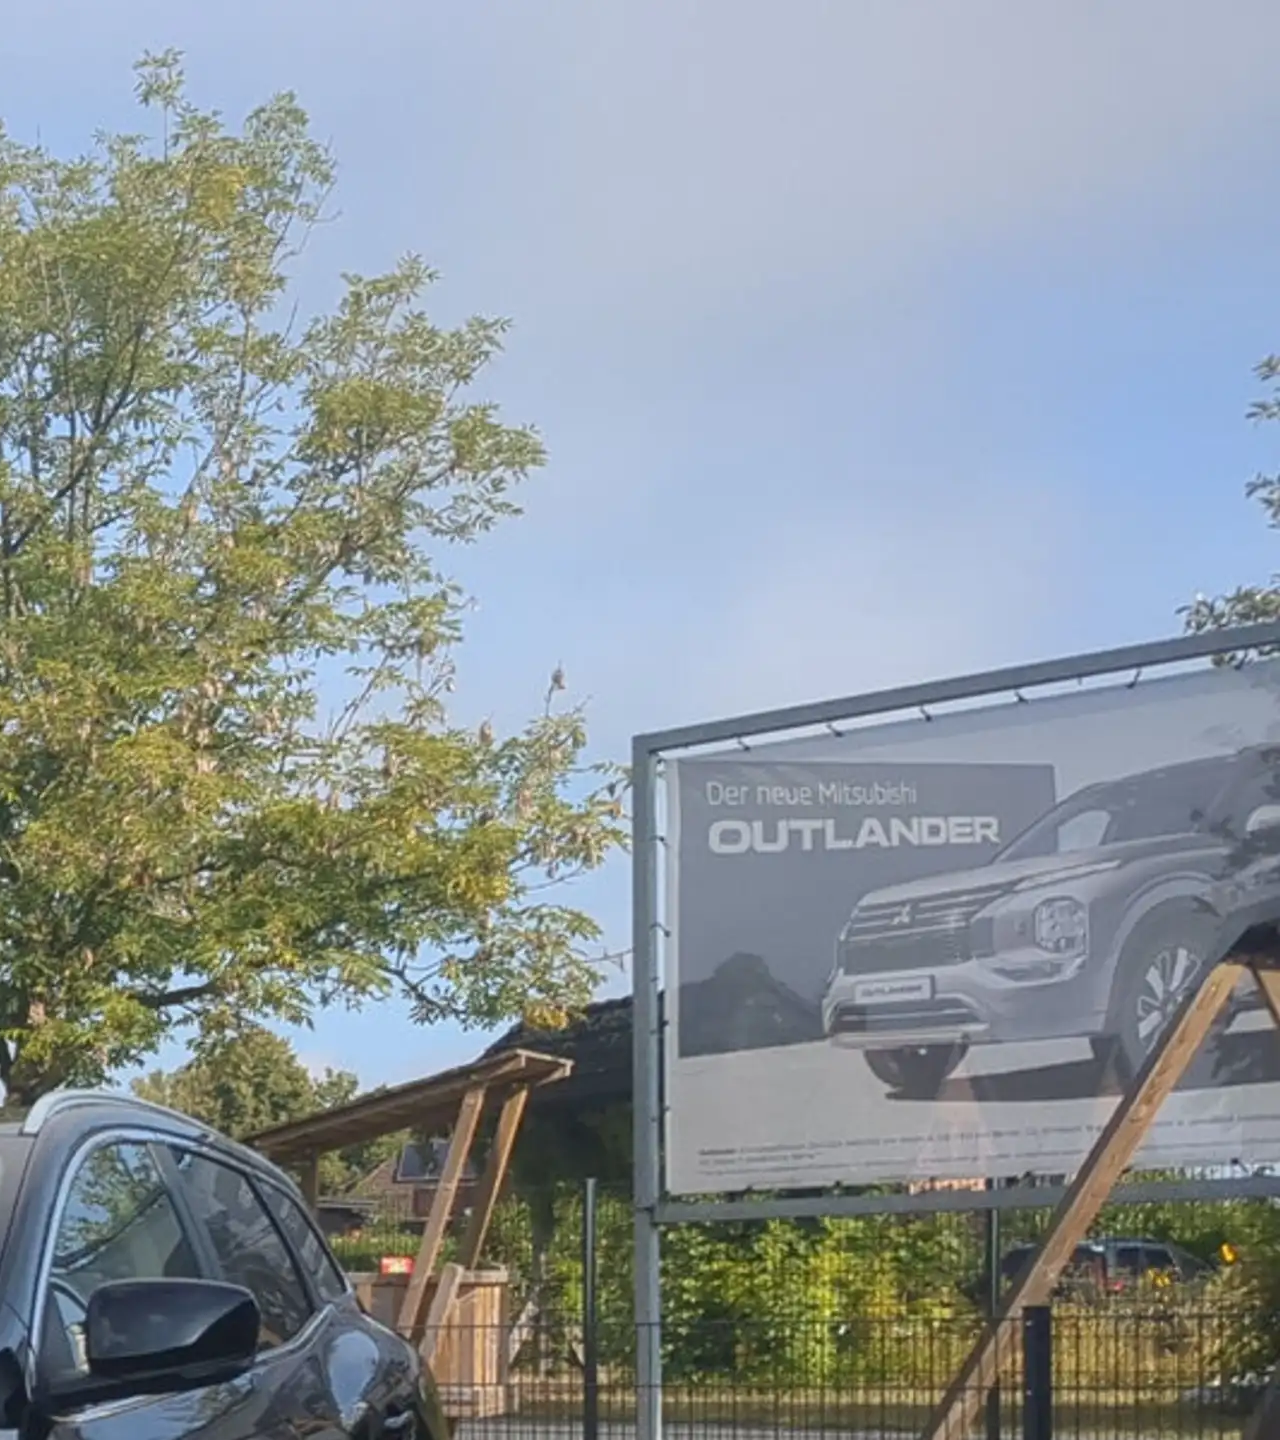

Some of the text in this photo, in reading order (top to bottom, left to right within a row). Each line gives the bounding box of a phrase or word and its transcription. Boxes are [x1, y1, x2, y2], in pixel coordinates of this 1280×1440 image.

[706, 781, 918, 806] Der neue Mitsubishi
[708, 816, 1001, 854] OUTLANDER
